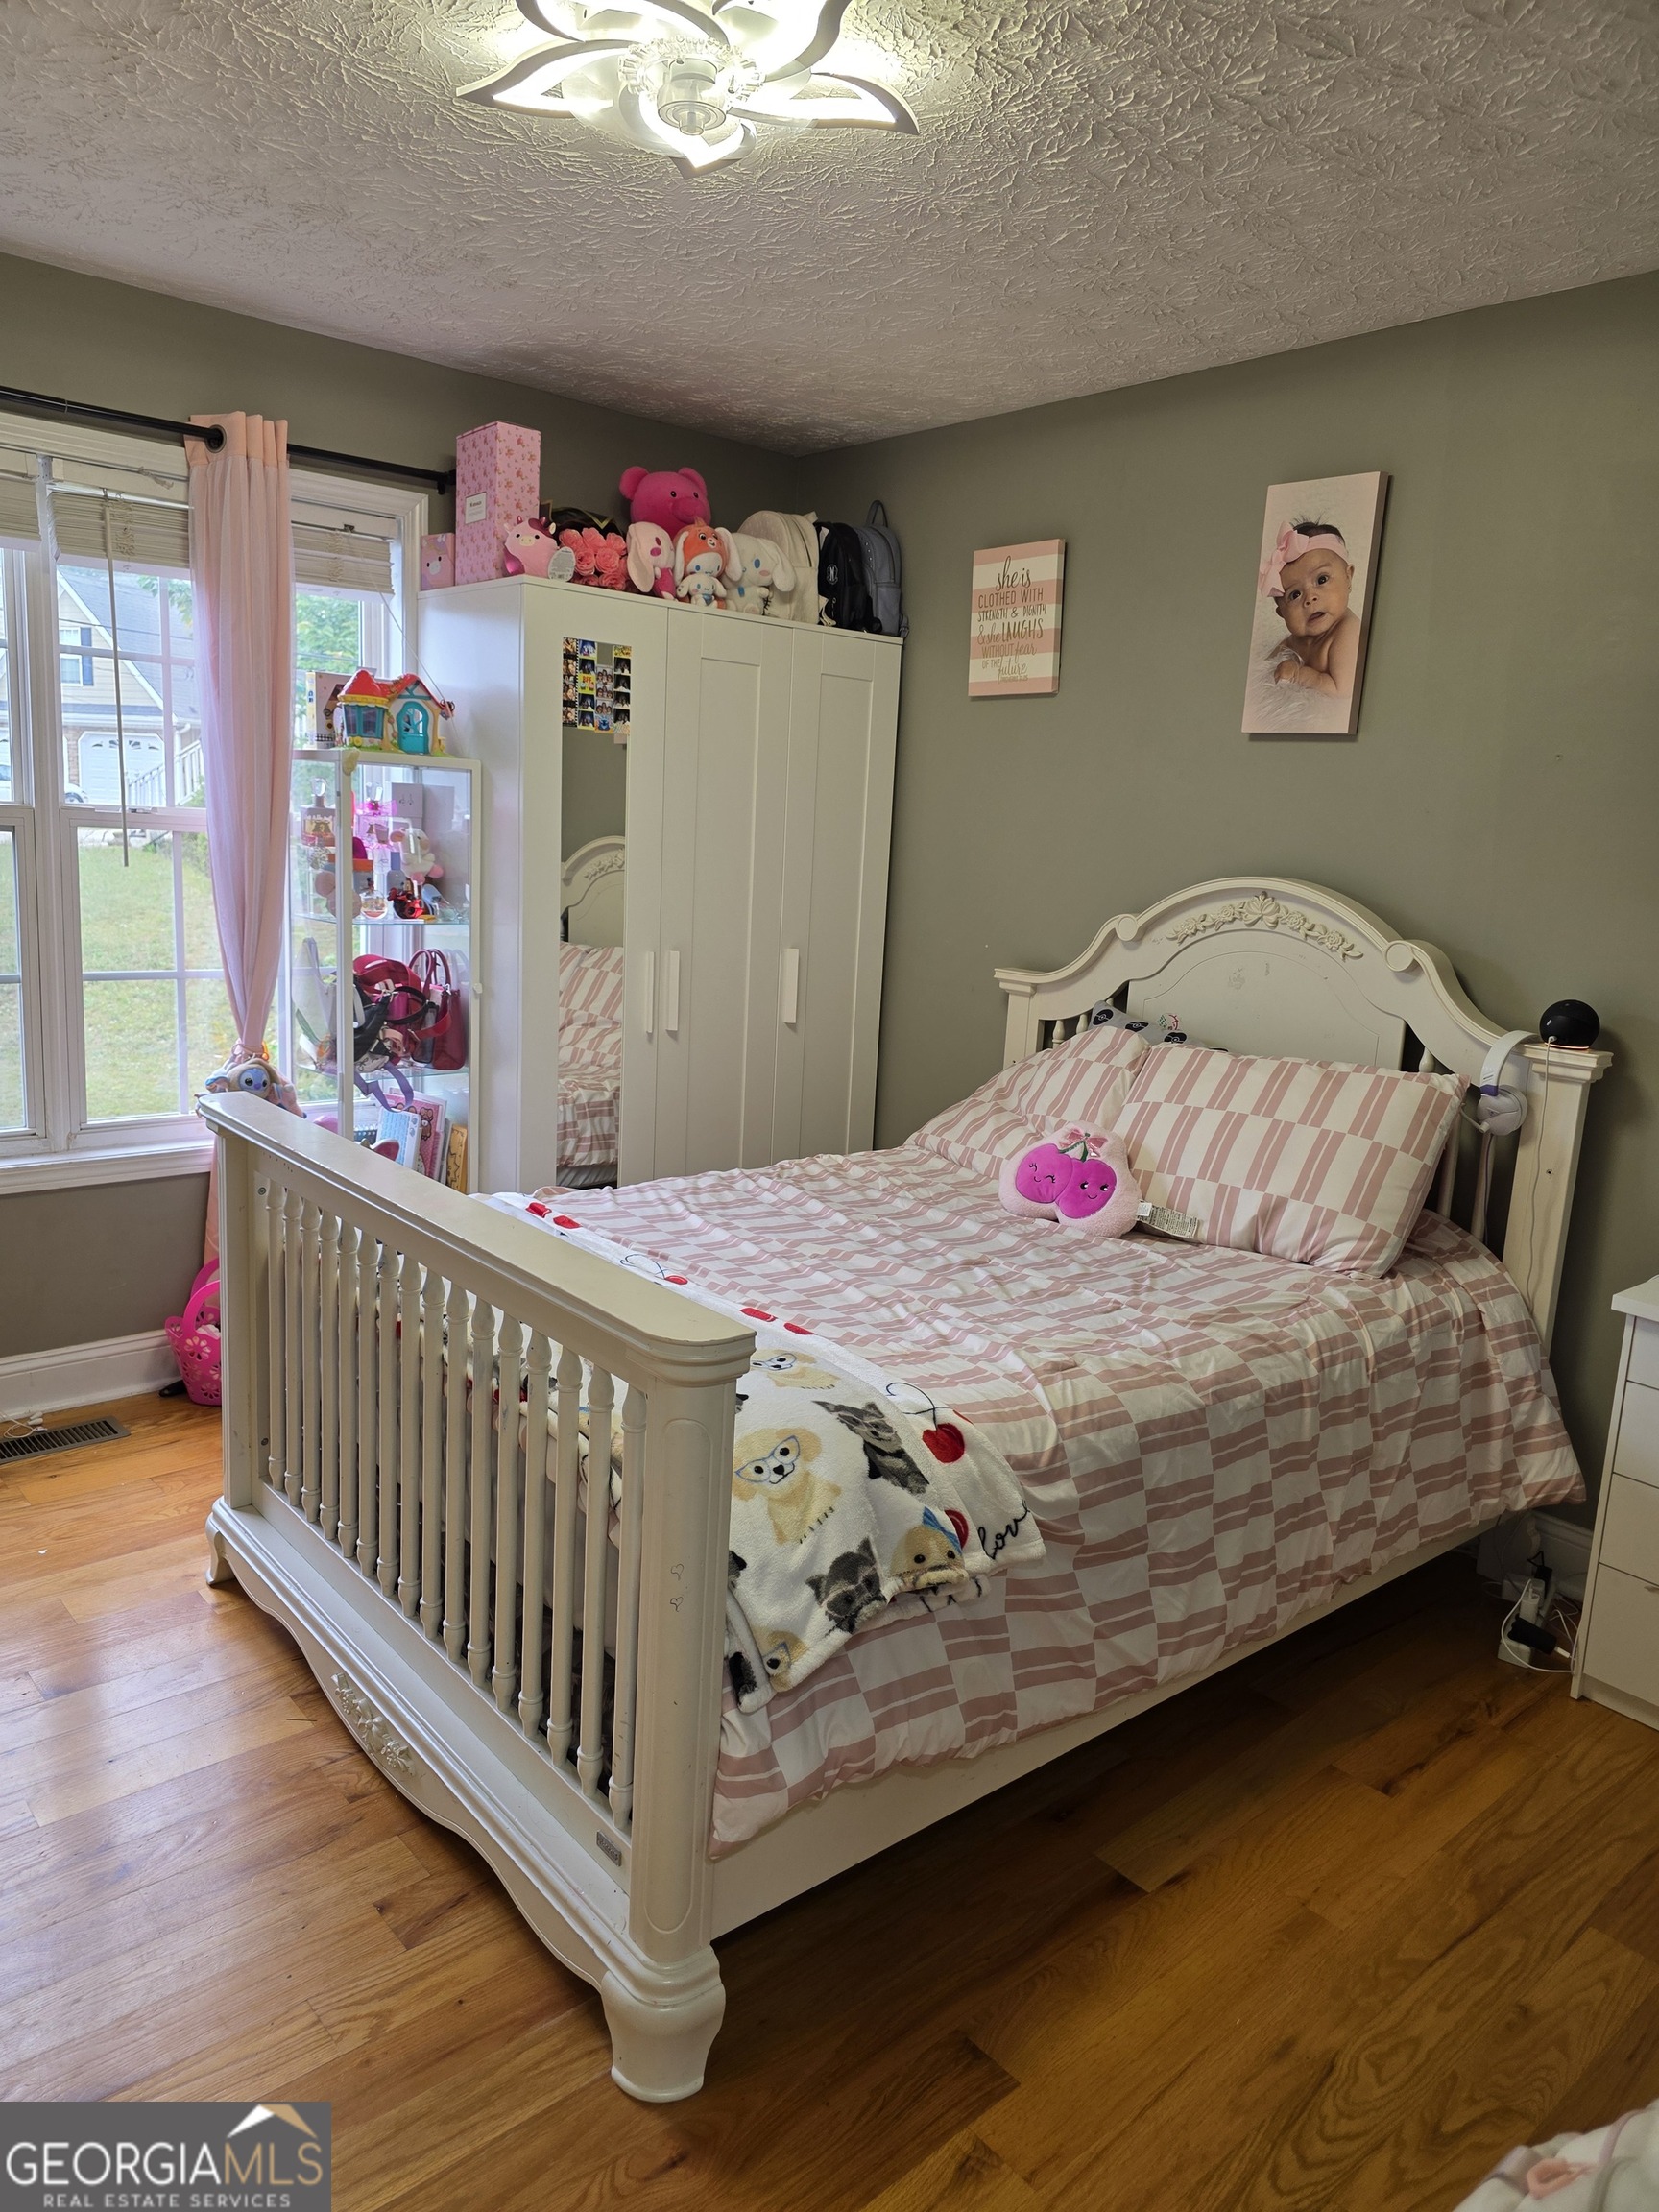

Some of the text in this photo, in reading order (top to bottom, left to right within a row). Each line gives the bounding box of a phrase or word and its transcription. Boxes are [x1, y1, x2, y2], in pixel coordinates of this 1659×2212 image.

[996, 555, 1031, 591] she is
[978, 587, 1044, 609] CLOTHED WITH
[977, 603, 1047, 623] STRENGTH & DIGNITY
[1002, 617, 1044, 642] LAUGHS
[981, 641, 1037, 664] WITHOUT fear
[982, 660, 989, 669] OF
[991, 659, 1000, 668] THE
[998, 656, 1028, 685] future
